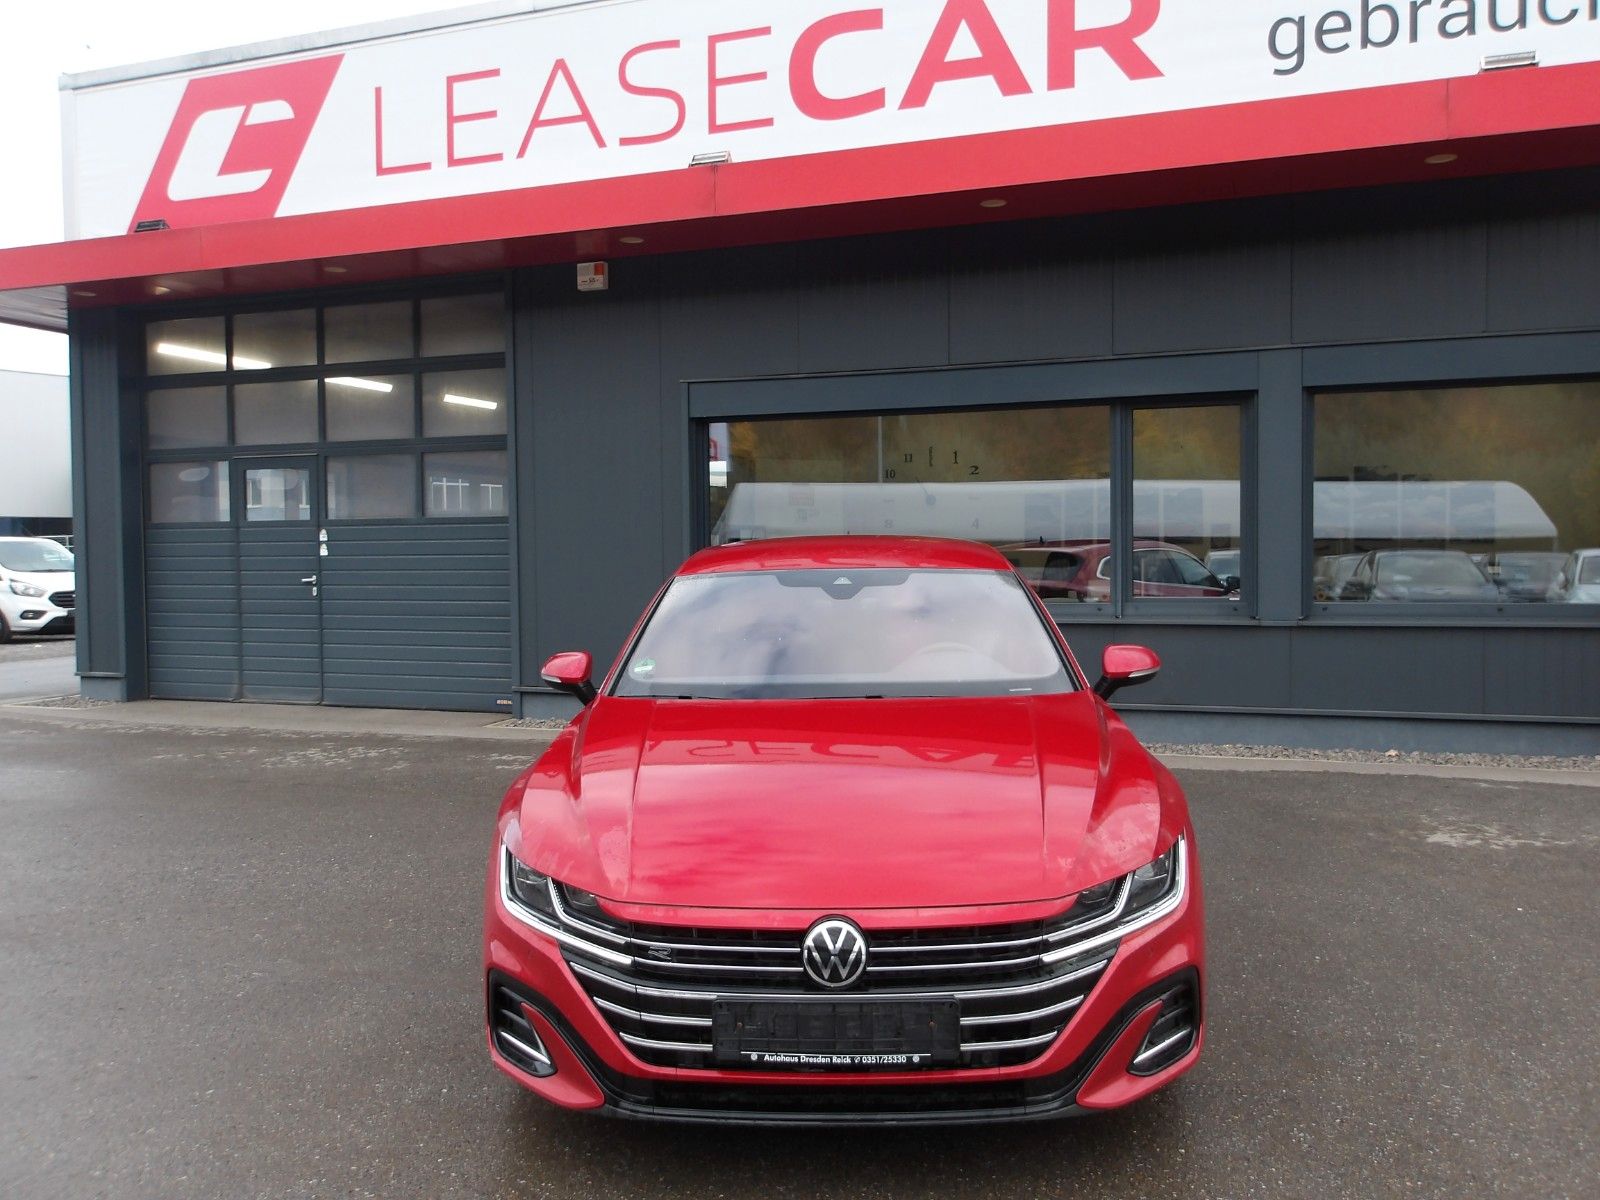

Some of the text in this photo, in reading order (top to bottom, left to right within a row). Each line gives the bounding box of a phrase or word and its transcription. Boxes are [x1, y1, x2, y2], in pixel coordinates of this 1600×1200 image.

[1267, 0, 1600, 75] gebrauc
[374, 0, 1165, 177] LEASECAR
[885, 468, 896, 479] 10
[969, 464, 980, 475] 2
[763, 1054, 799, 1062] Autohaus
[800, 1056, 831, 1064] Dresden
[862, 1055, 907, 1064] 0351/25330
